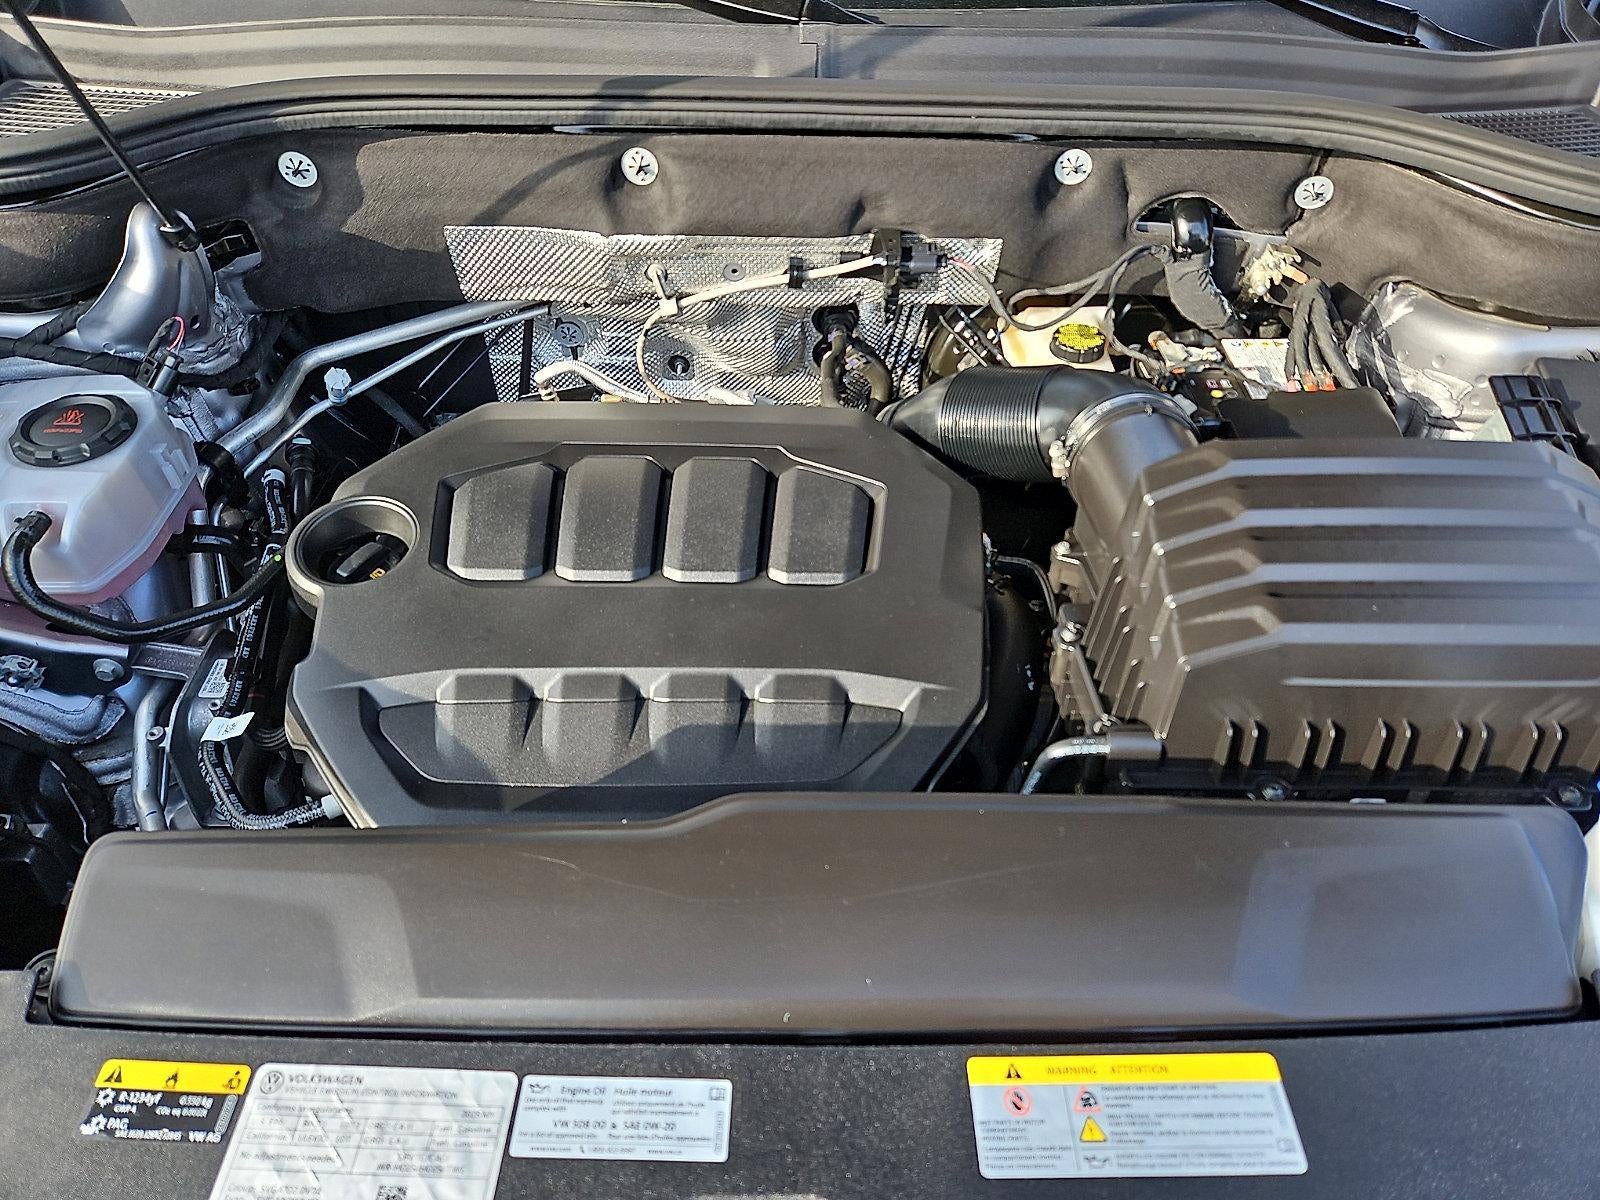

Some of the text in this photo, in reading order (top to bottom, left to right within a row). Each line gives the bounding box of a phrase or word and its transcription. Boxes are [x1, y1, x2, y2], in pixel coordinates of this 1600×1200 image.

[288, 1073, 363, 1084] VOLKSWAGEN
[560, 1087, 607, 1097] Engine Oil
[614, 1088, 673, 1097] Huile moteur
[107, 1117, 130, 1130] PAG
[188, 1131, 205, 1143] VW
[205, 1132, 222, 1144] AG
